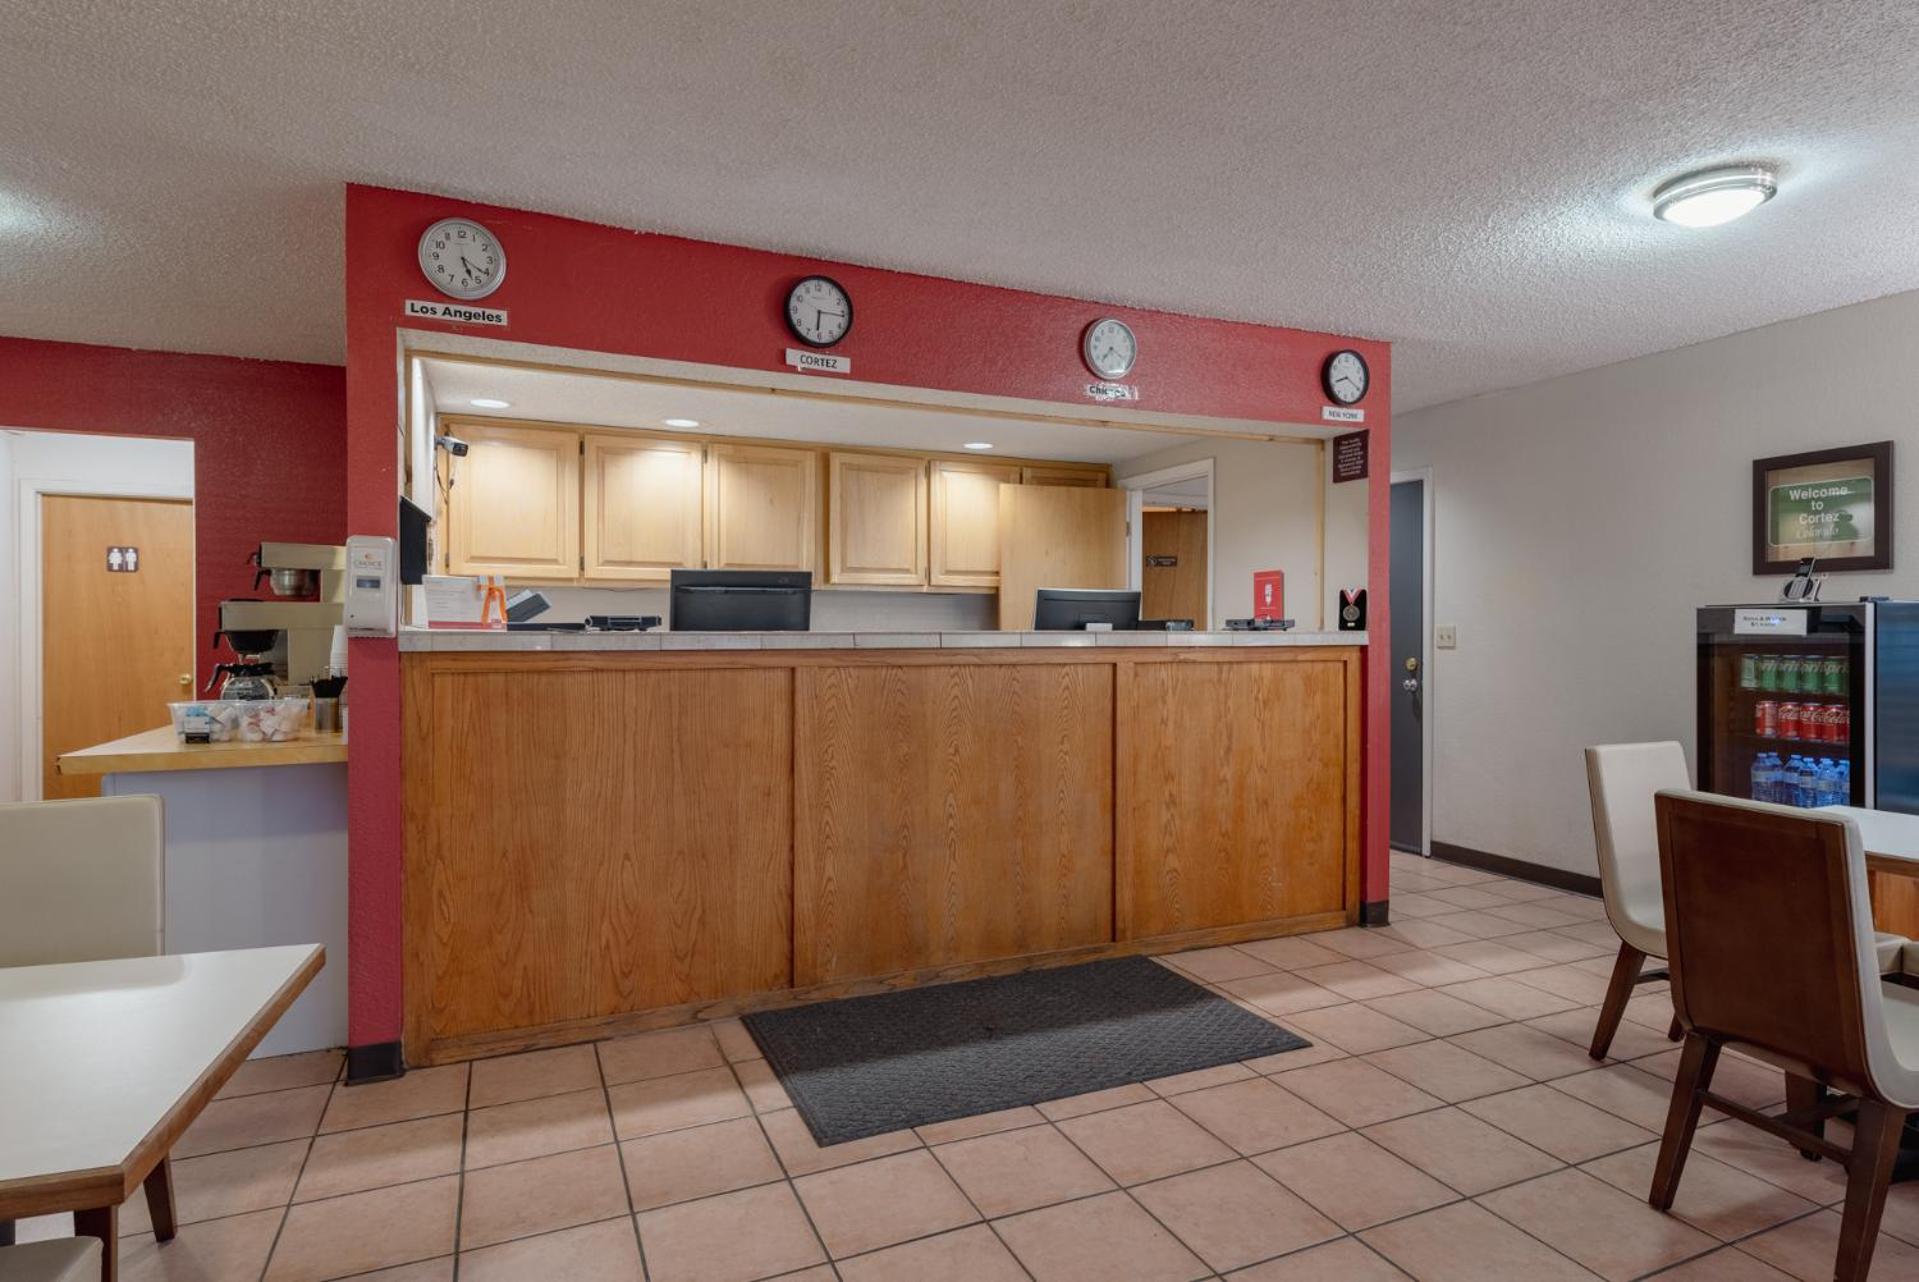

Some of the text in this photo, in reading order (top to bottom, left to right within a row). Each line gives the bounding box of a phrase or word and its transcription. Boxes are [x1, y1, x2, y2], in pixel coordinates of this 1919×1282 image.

[457, 231, 466, 239] 12
[435, 240, 445, 249] 10
[481, 244, 488, 252] 2
[432, 252, 439, 260] 9
[486, 256, 493, 264] 3
[437, 265, 445, 273] 8
[448, 274, 455, 282] 7
[461, 278, 468, 287] 6
[410, 302, 502, 323] Los Angeles
[800, 354, 838, 368] CORTEZ
[1789, 486, 1849, 501] Welcome
[1811, 500, 1824, 510] to
[1799, 512, 1840, 525] Cortez
